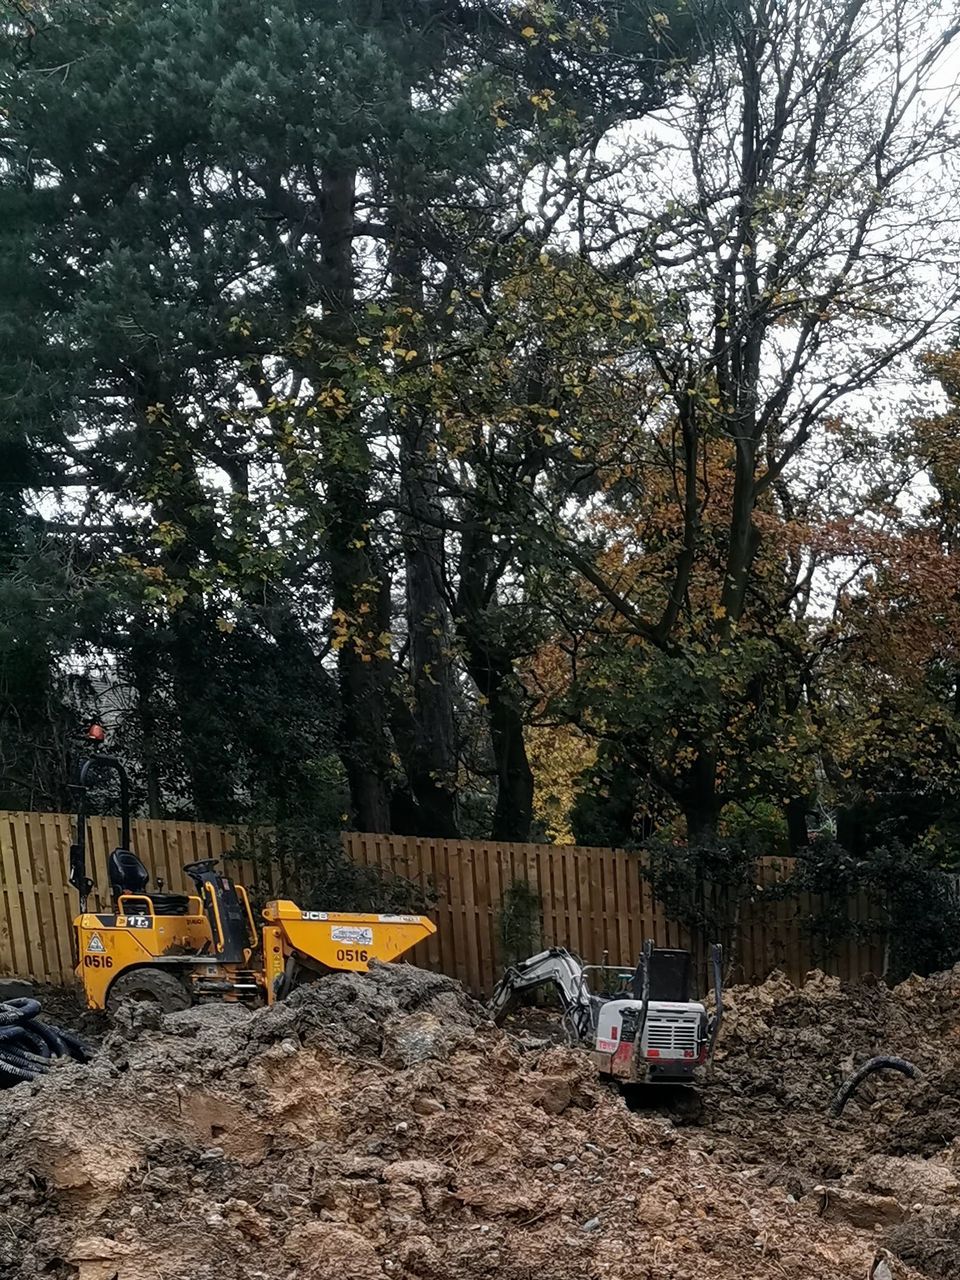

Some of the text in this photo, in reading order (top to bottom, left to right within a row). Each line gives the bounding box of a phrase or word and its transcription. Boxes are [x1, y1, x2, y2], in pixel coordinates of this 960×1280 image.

[302, 911, 328, 920] JCB
[84, 954, 113, 968] 0516
[336, 950, 368, 962] 0516
